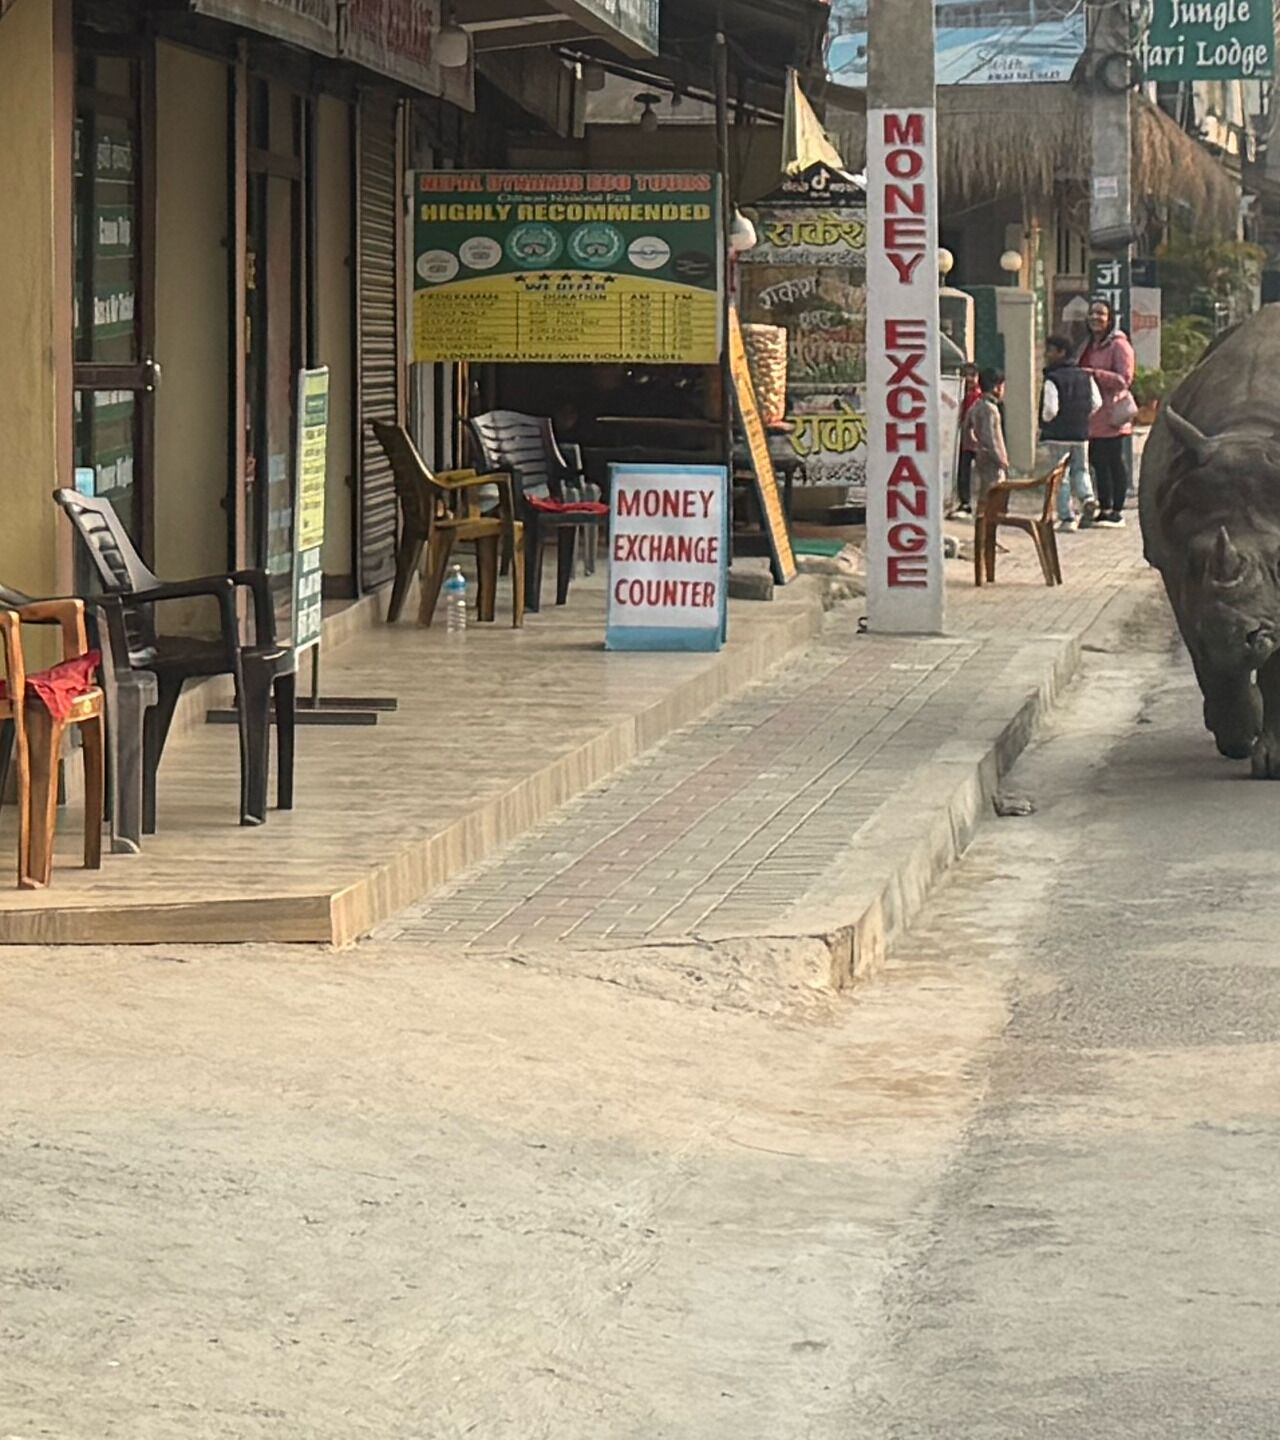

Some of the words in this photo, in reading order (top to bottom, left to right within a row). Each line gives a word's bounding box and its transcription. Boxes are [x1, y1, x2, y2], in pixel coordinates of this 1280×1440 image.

[1196, 36, 1269, 75] Lodge
[634, 173, 711, 192] TOURS
[421, 204, 512, 221] HIGHLY
[517, 203, 711, 221] RECOMMENDED
[884, 113, 928, 284] MONEY
[785, 398, 867, 458] राके
[884, 318, 930, 589] EXCHANGE
[616, 489, 715, 519] MONEY
[613, 534, 719, 564] EXCHANGE
[614, 578, 716, 608] COUNTER
